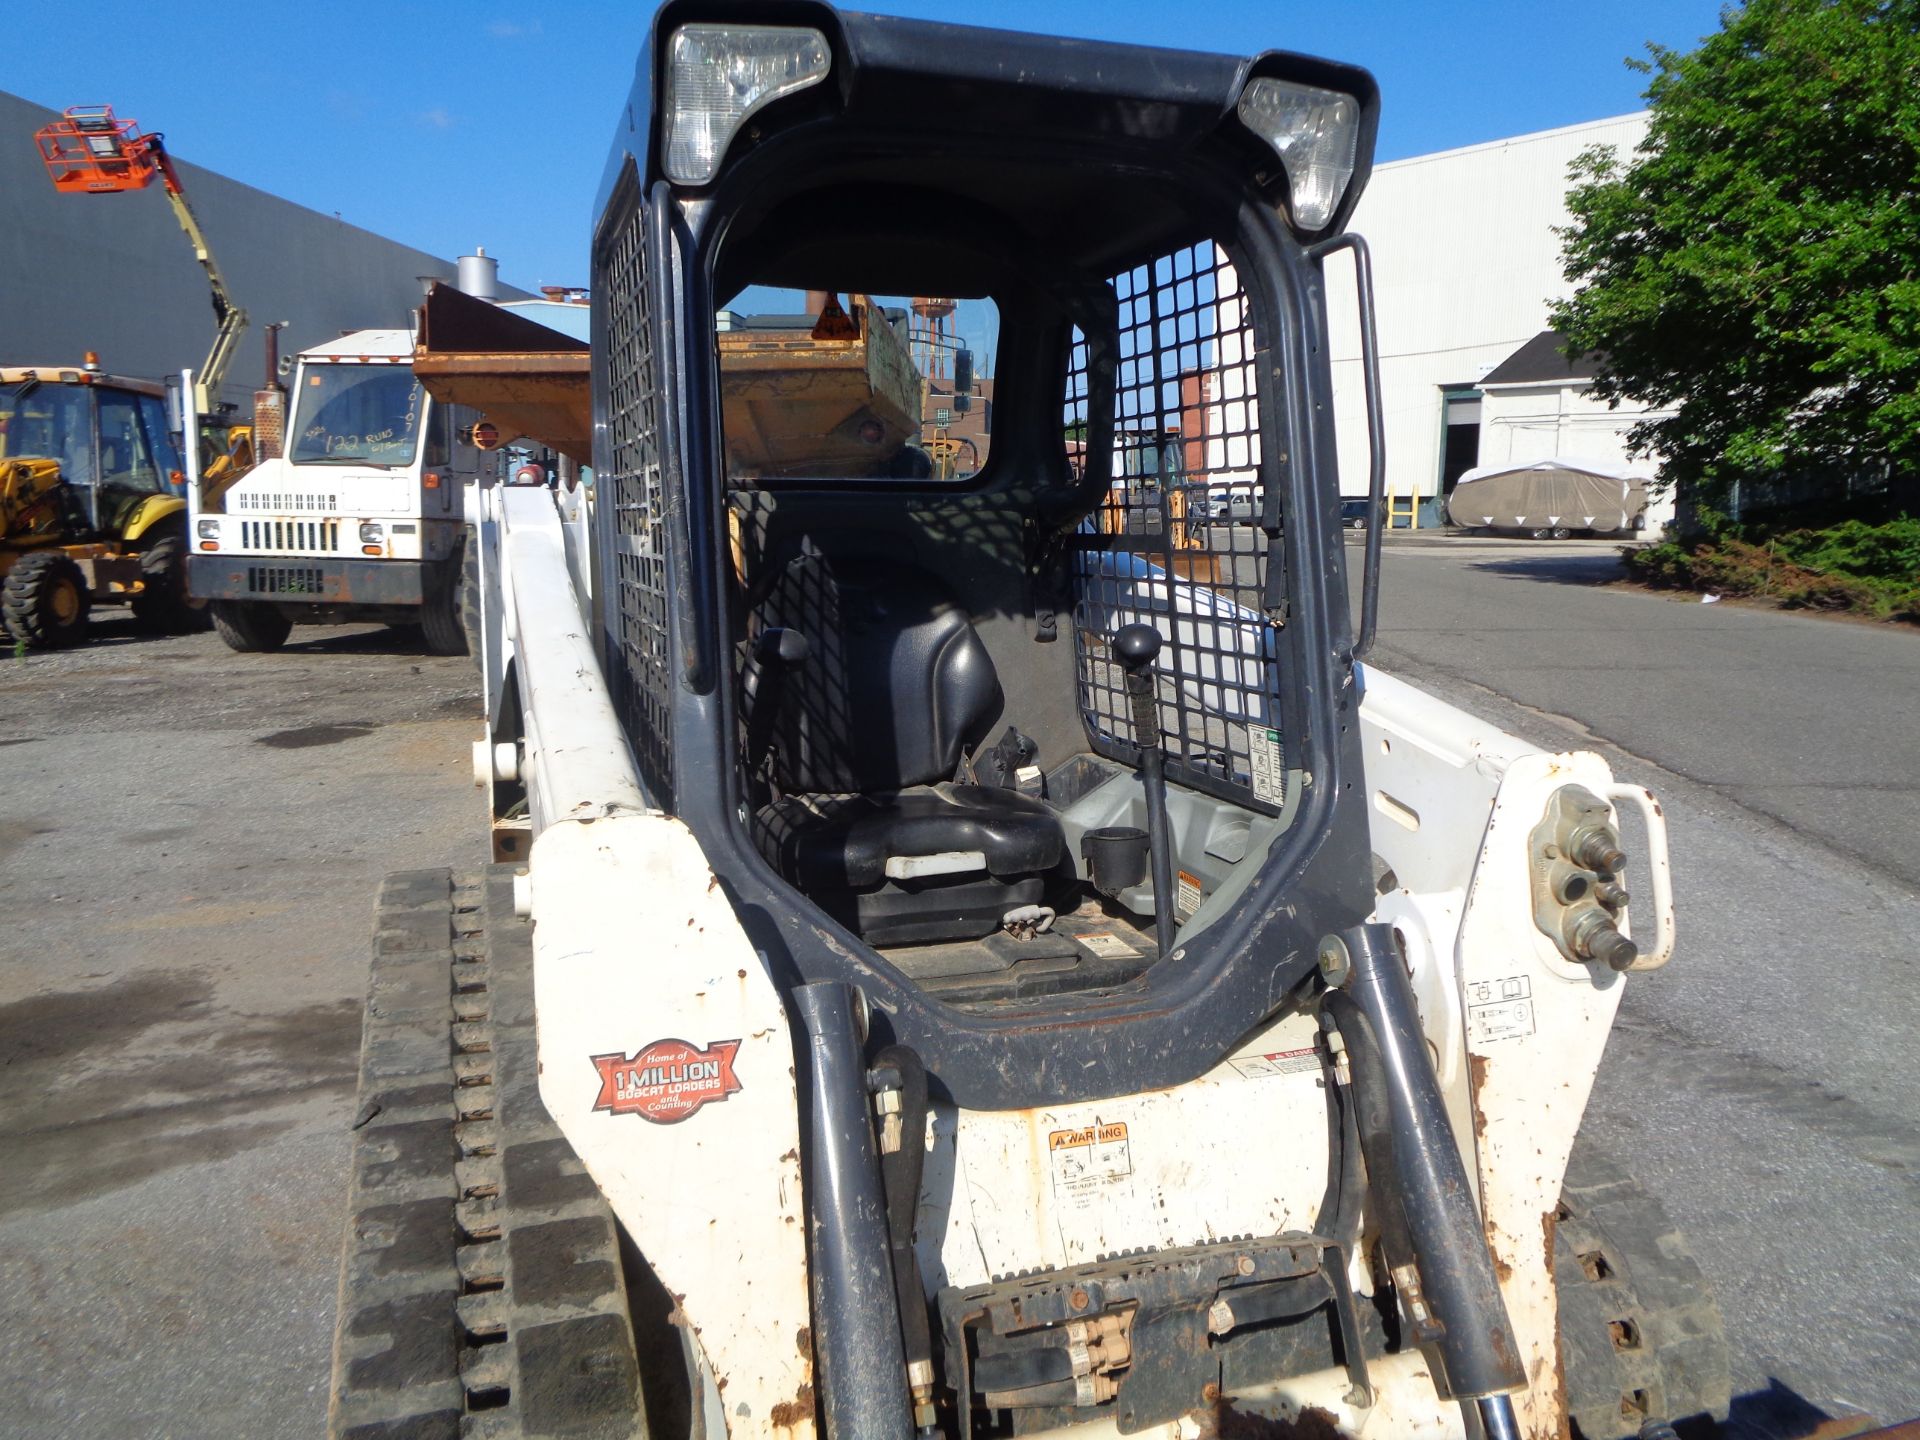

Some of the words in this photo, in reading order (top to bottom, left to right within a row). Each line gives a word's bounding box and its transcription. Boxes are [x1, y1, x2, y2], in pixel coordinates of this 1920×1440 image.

[646, 1054, 675, 1064] Home
[677, 1050, 688, 1062] of
[614, 1071, 625, 1090] 1
[629, 1060, 720, 1088] MILLION
[616, 1085, 666, 1100] BOBCAT
[668, 1080, 721, 1094] LOADERS
[660, 1094, 679, 1103] and
[647, 1100, 693, 1112] Counting
